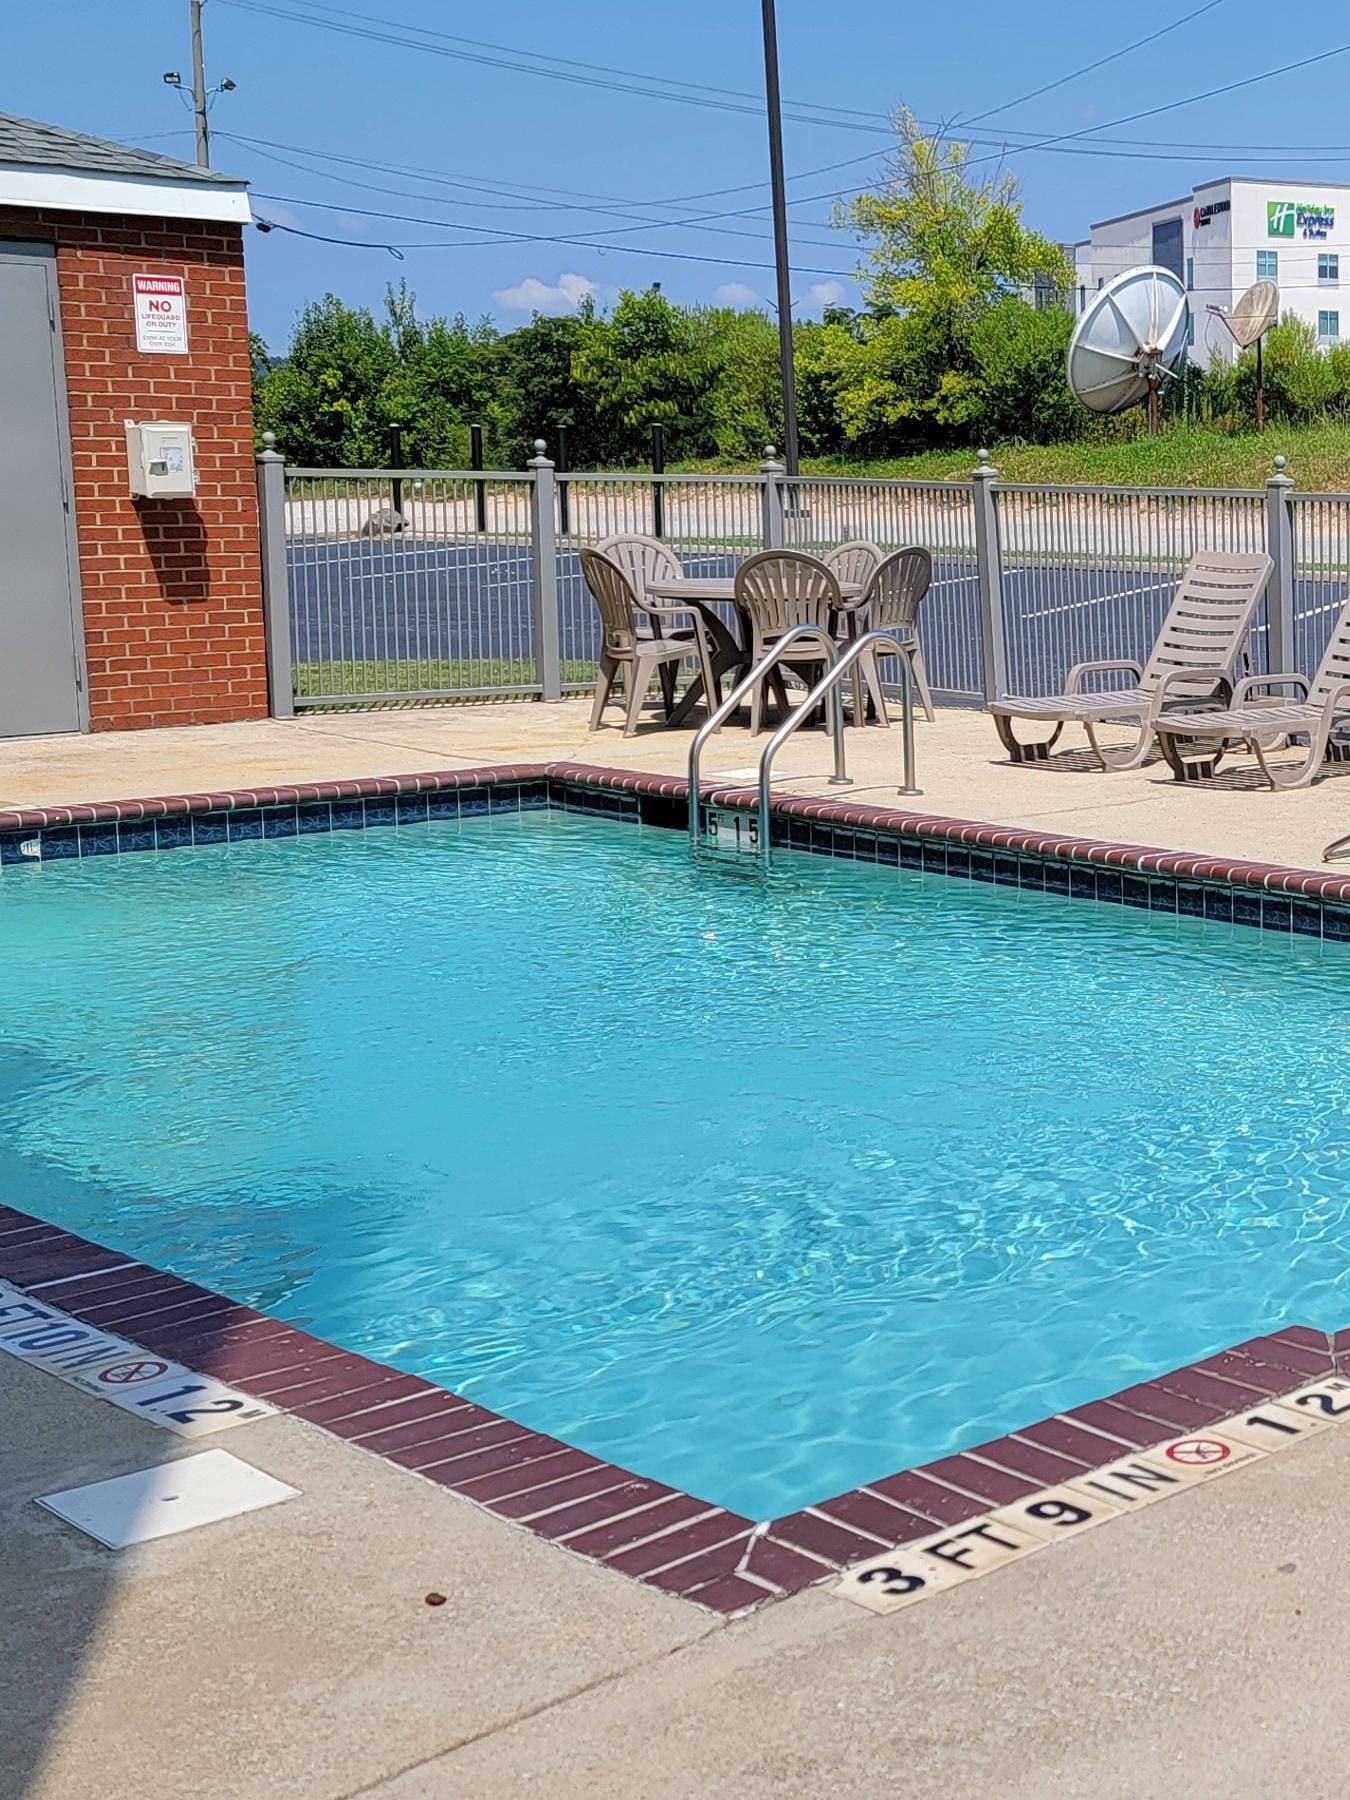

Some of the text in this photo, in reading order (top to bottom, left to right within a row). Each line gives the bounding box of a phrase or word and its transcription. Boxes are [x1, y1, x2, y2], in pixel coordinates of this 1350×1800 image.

[137, 280, 181, 293] WARNING
[149, 300, 172, 312] NO
[159, 321, 177, 329] DUTY
[707, 811, 719, 836] 5
[856, 1566, 926, 1596] 3
[920, 1523, 1021, 1570] FT
[1024, 1499, 1093, 1526] 9
[1084, 1463, 1182, 1501] IN
